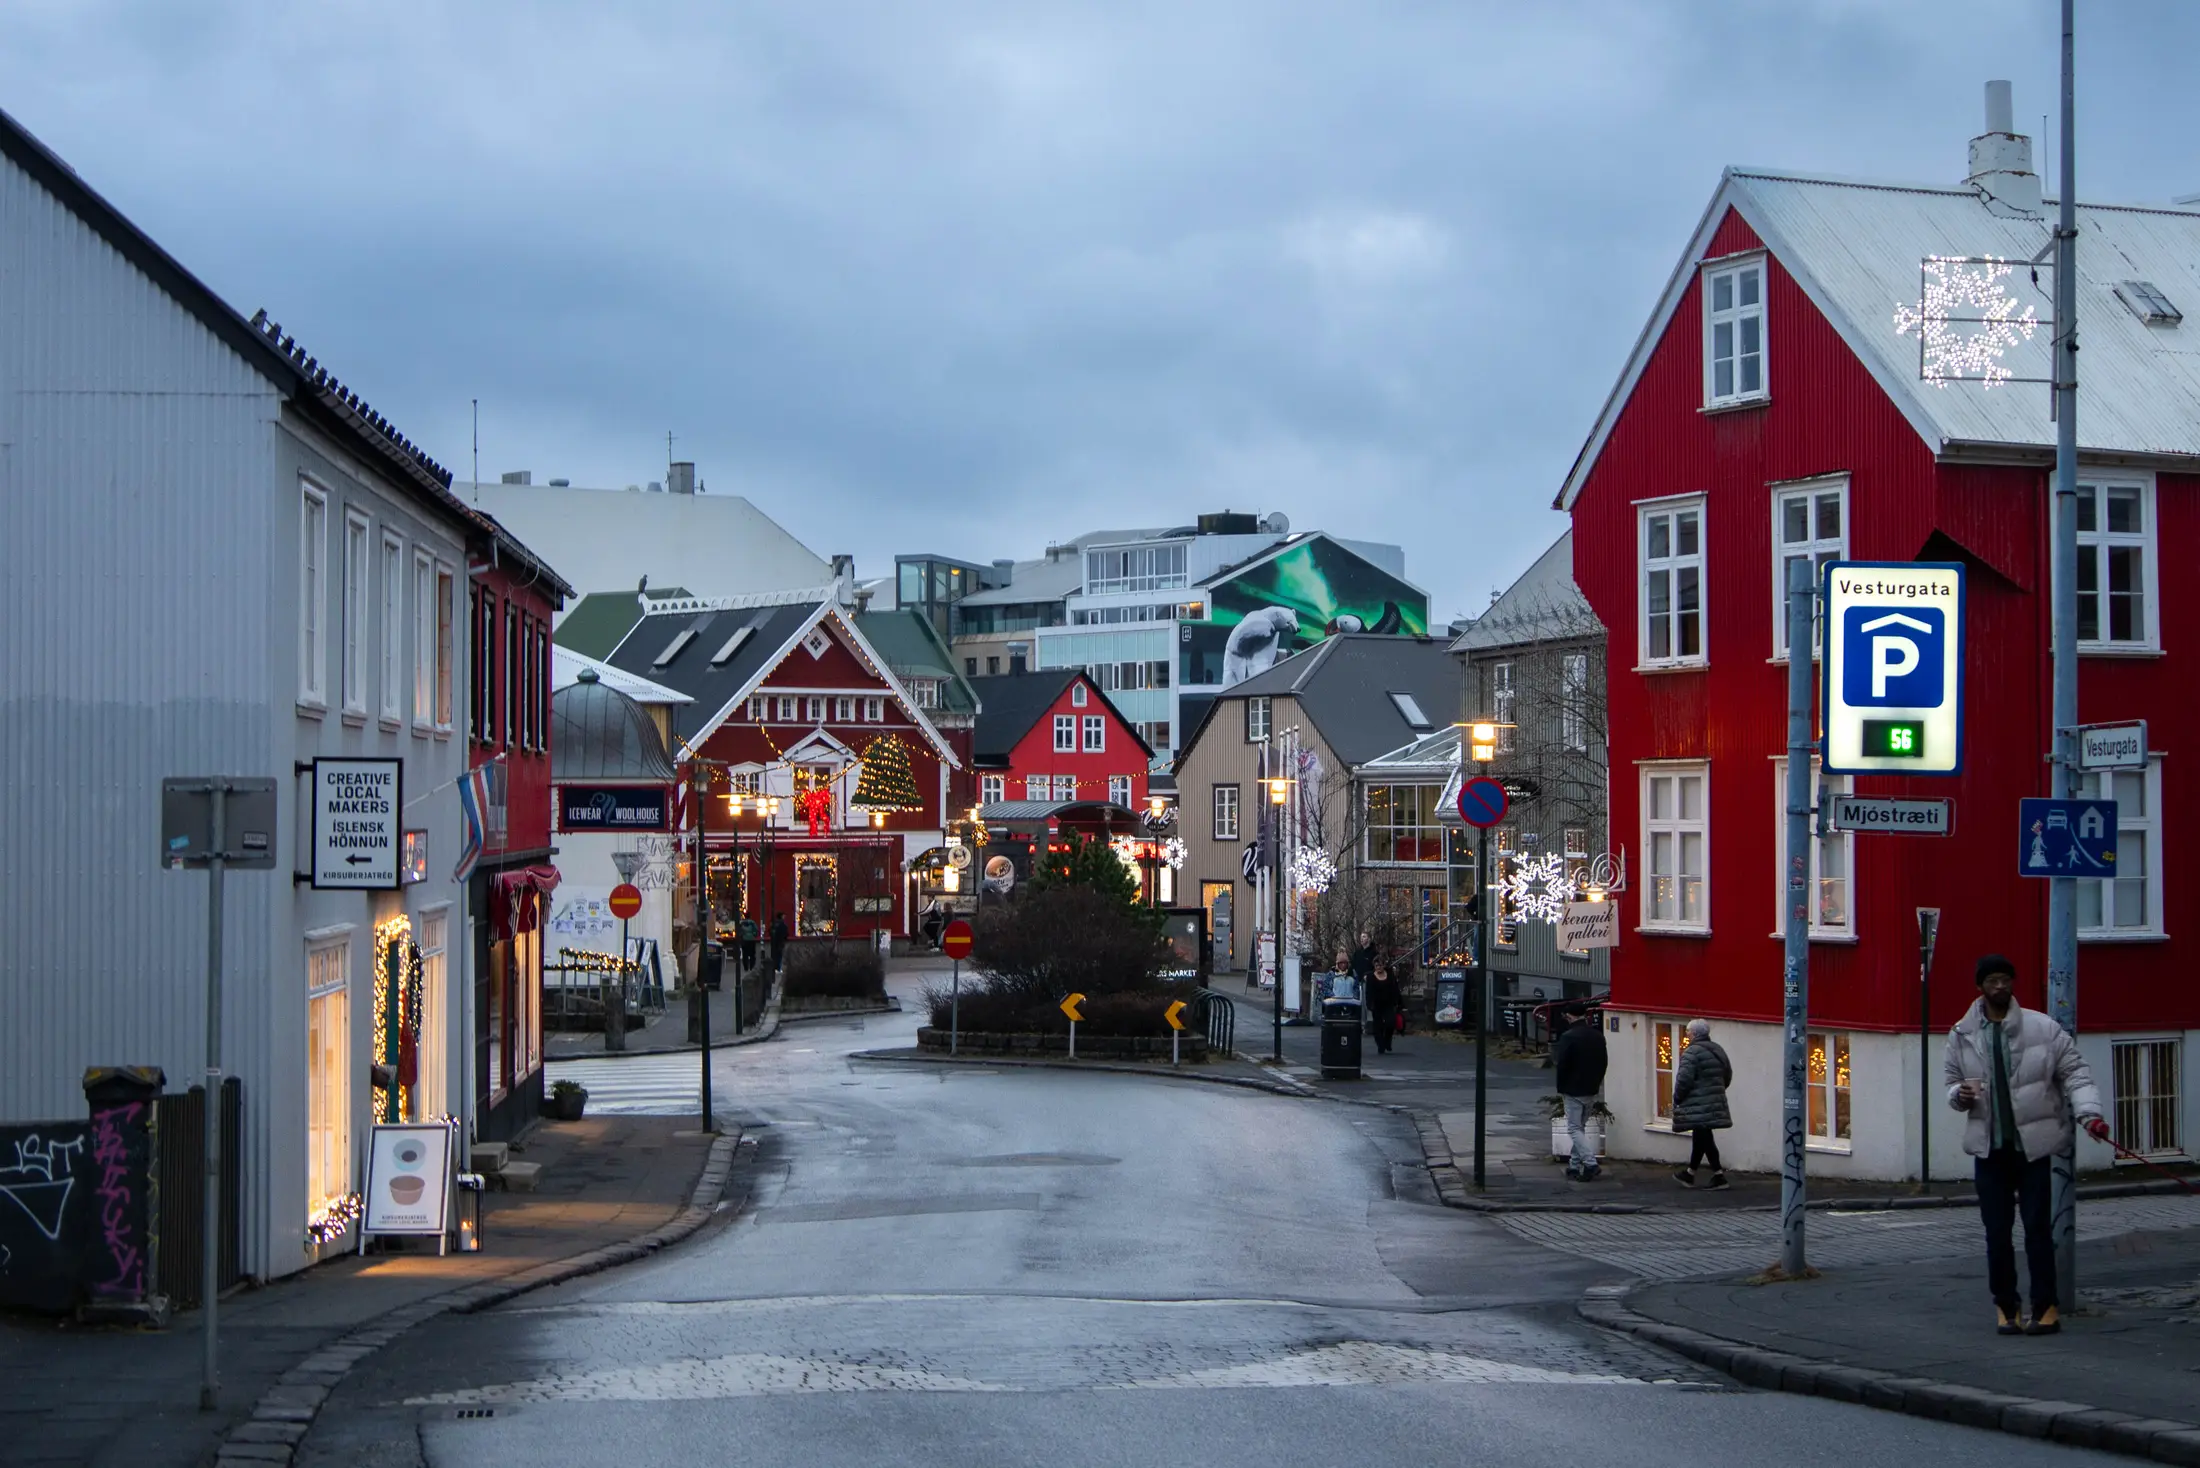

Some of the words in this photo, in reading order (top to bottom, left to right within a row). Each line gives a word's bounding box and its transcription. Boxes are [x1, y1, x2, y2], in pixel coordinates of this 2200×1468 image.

[1839, 579, 1951, 599] Vesturgata
[1871, 635, 1920, 698] P
[1890, 728, 1913, 750] 56
[2086, 736, 2138, 760] Vesturgata
[327, 772, 391, 785] CREATIVE
[336, 786, 382, 799] LOCAL
[328, 800, 389, 814] MAKERS
[569, 807, 601, 820] ICEWEAR
[1844, 805, 1938, 825] Mjóstræti
[332, 818, 385, 833] ÍSLENSK
[328, 832, 388, 848] HÖNNUN
[1561, 905, 1614, 926] keramik
[1168, 969, 1197, 977] MARKET
